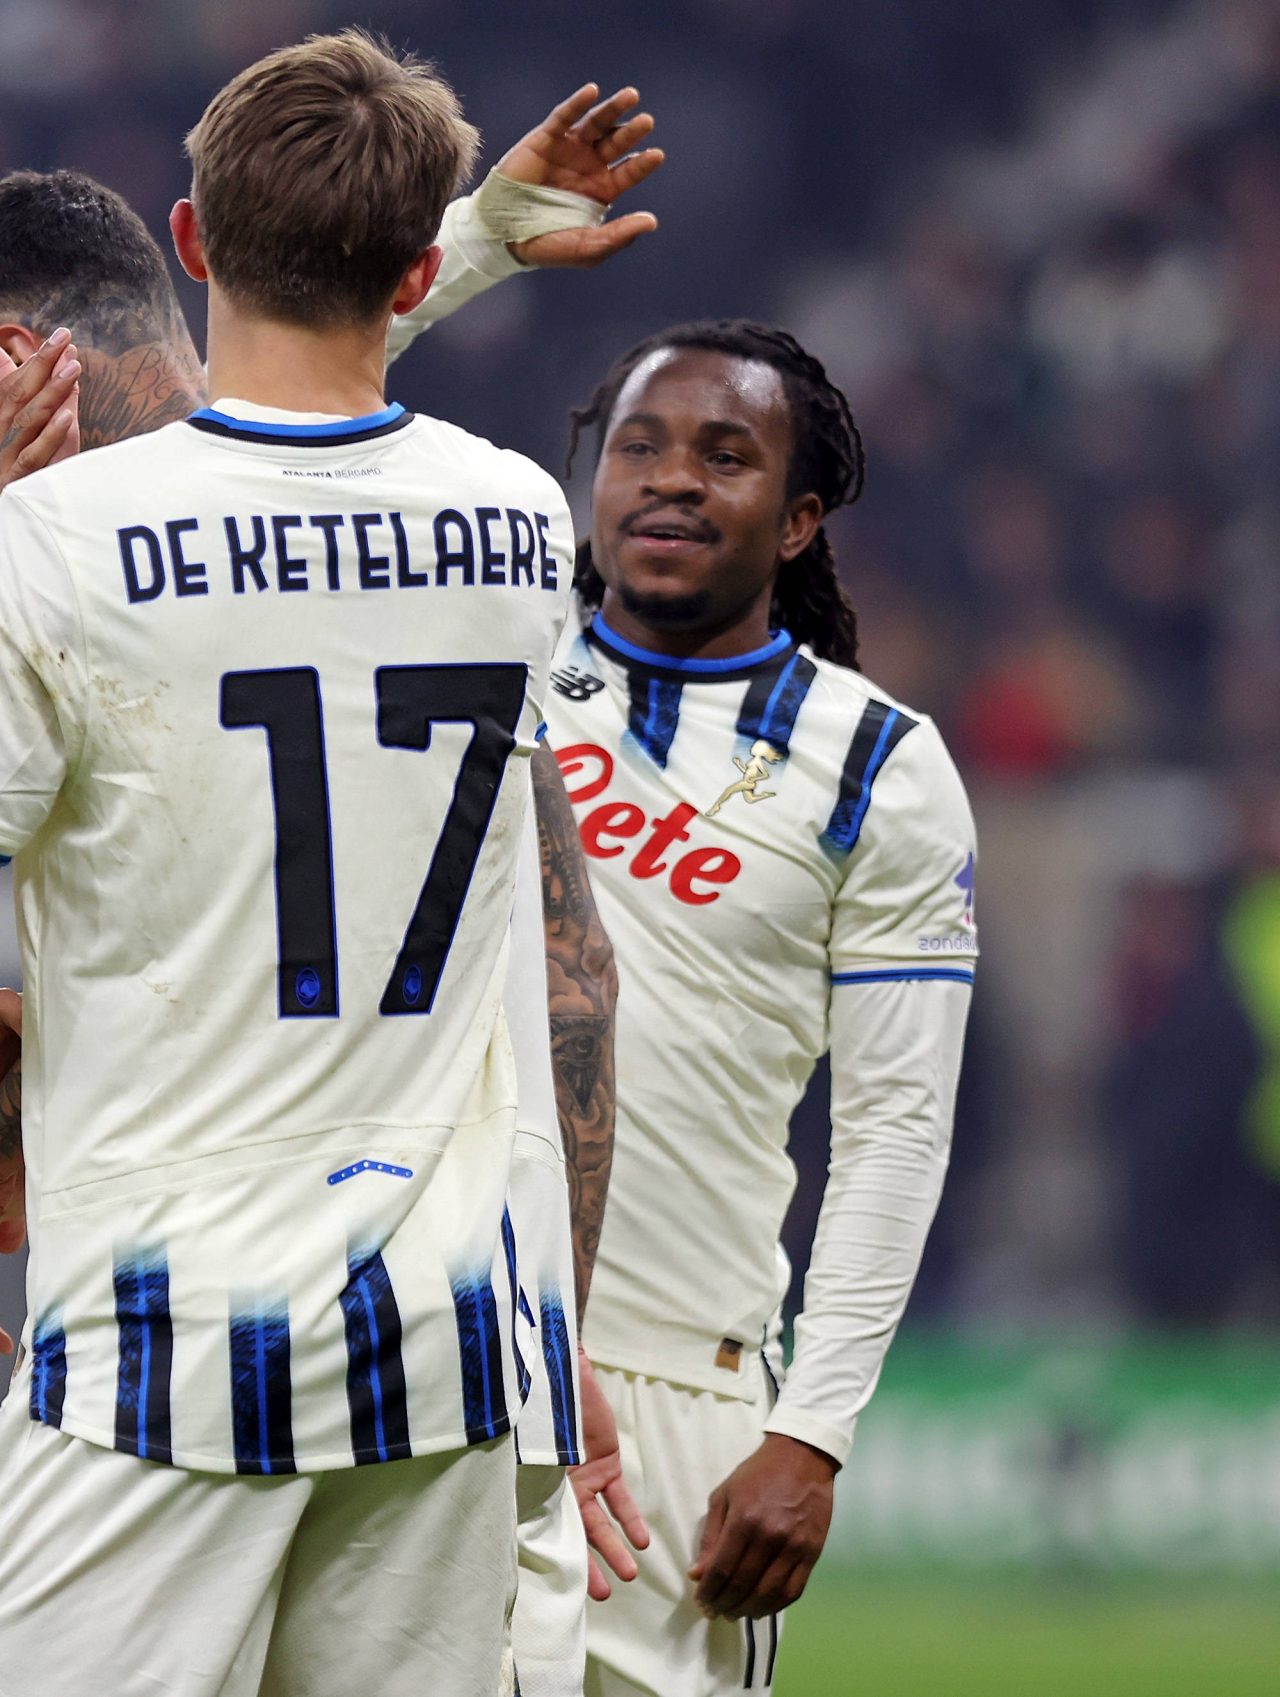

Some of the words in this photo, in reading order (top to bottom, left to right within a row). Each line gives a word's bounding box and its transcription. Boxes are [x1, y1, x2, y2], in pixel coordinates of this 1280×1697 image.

[282, 470, 332, 478] ATALANTA
[335, 467, 381, 479] BERGAMO
[117, 517, 210, 605] DE
[224, 507, 558, 594] KETELAERE
[219, 662, 529, 1020] 17
